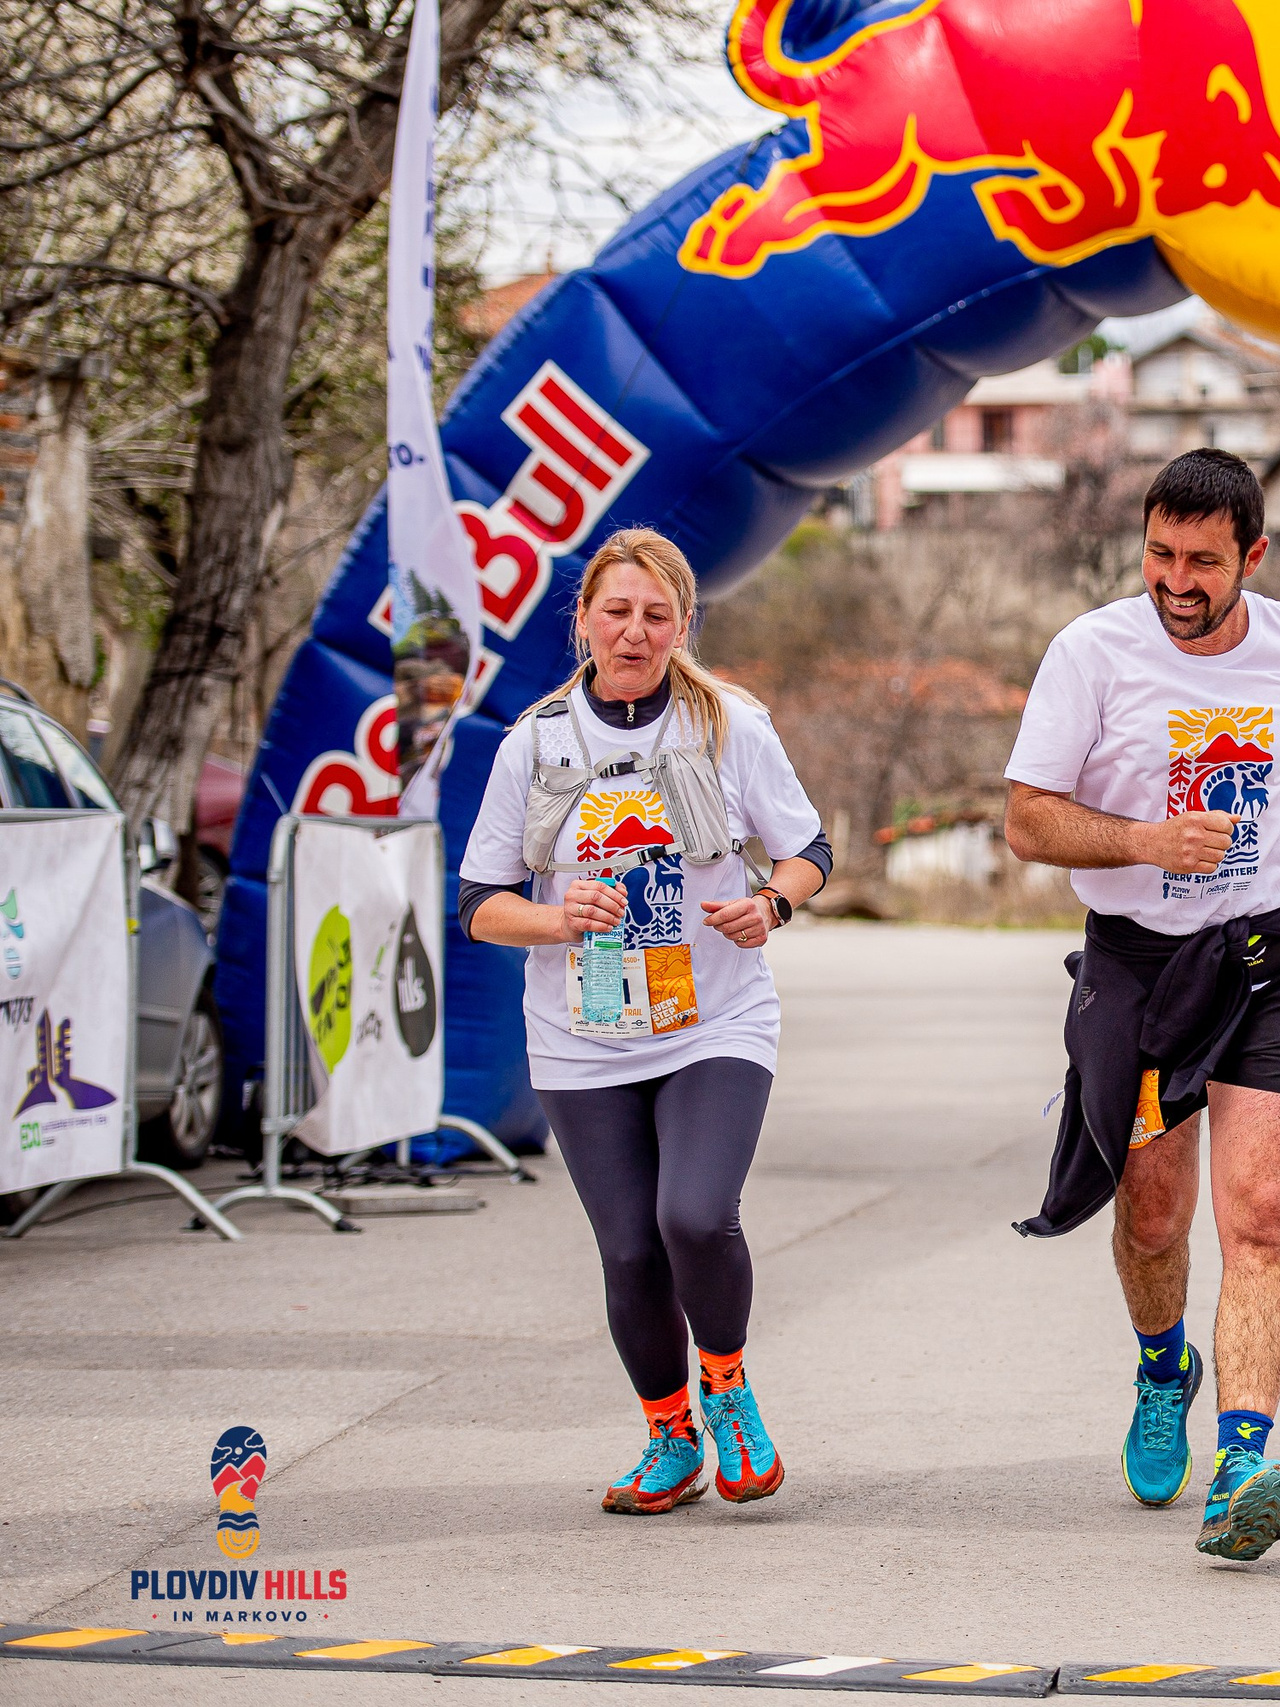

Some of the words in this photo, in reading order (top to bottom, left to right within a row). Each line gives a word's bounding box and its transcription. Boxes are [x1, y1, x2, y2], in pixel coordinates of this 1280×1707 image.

[1194, 874, 1218, 884] STEP
[1218, 866, 1259, 879] MATTERS
[624, 1008, 643, 1017] TRAIL
[651, 1006, 676, 1022] STEP
